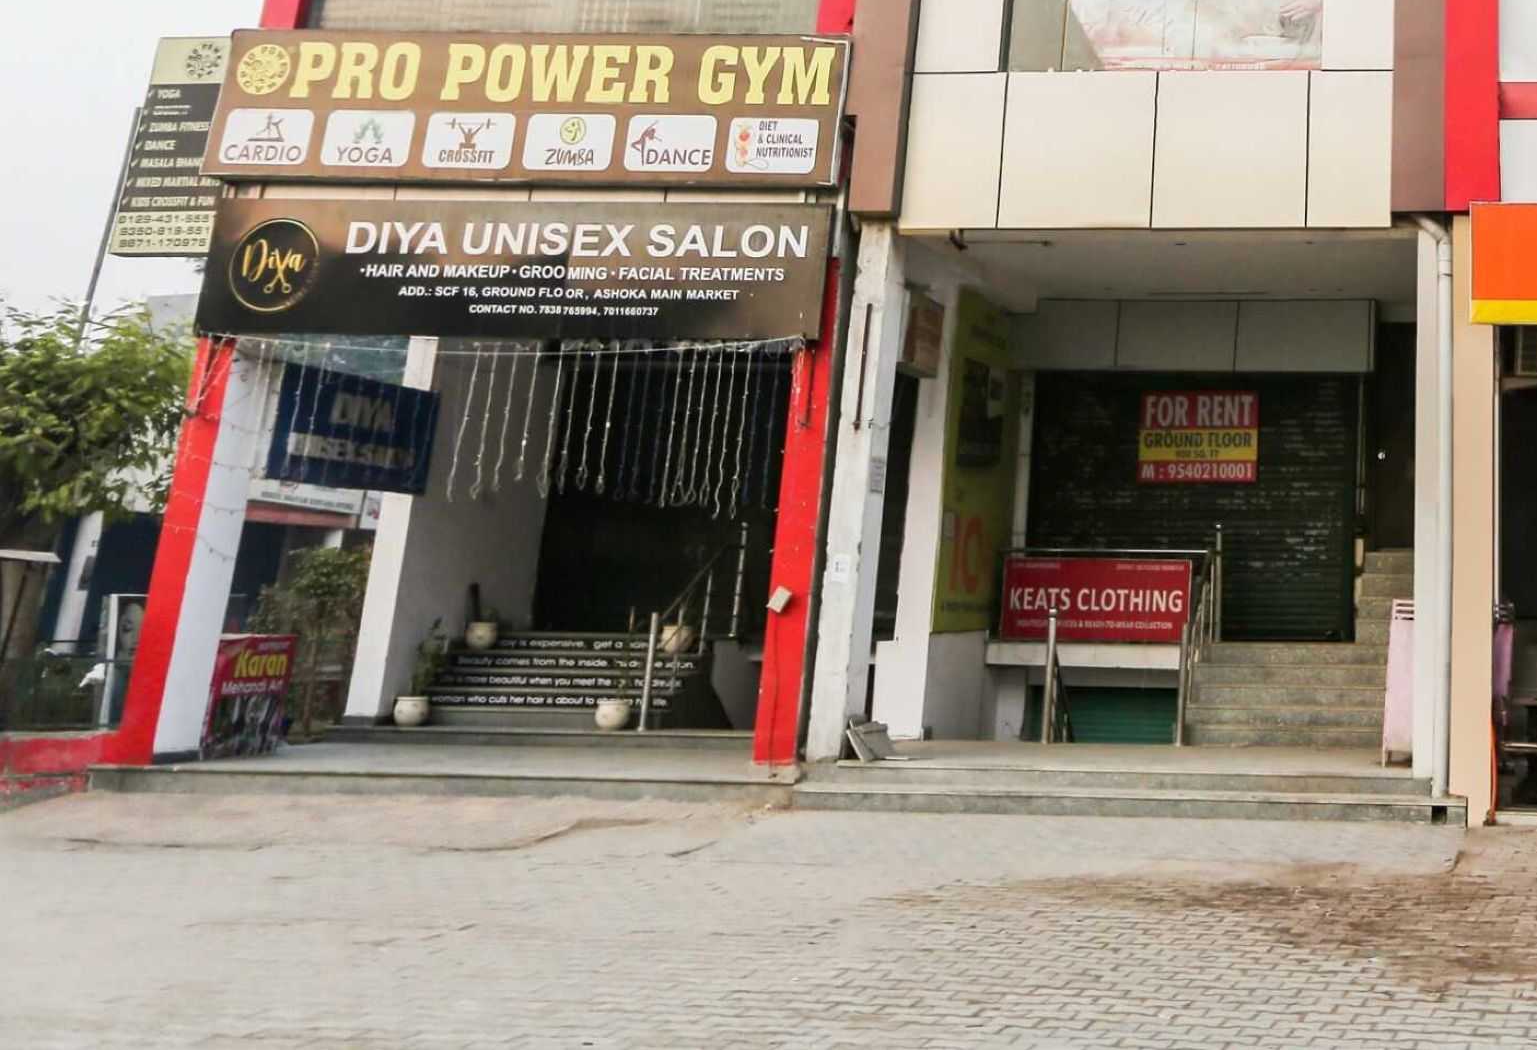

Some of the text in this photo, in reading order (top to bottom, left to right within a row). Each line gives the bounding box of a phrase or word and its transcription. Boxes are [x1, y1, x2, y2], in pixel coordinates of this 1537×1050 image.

[289, 41, 422, 101] PRO
[440, 43, 675, 104] POWER
[698, 45, 836, 105] GYM
[758, 121, 779, 132] DIET
[765, 134, 804, 145] CLINICAL
[224, 144, 302, 162] CARDIO
[336, 146, 393, 164] YOGA
[438, 149, 495, 164] CROSSFIT
[544, 148, 595, 167] ZUMBA
[645, 149, 712, 166] DANCE
[756, 147, 814, 159] NUTRITIONIST
[345, 221, 809, 258] DIYA UNISEX SALON
[365, 265, 406, 278] HAIR
[406, 265, 440, 278] AND
[444, 265, 510, 278] MAKEUP
[617, 266, 675, 281] FACIAL
[680, 267, 785, 282] TREATMENTS
[435, 286, 460, 297] SCF
[482, 287, 536, 298] GROUND
[593, 288, 647, 299] ASHOKA
[650, 289, 682, 300] MAIN
[686, 289, 740, 300] MARKET
[469, 304, 517, 314] CONTACT
[1145, 395, 1254, 427] FOR RENT
[1144, 432, 1252, 448] GROUND FLOOR
[1167, 463, 1253, 479] 9540210001
[1009, 587, 1184, 613] KEATS CLOTHING
[233, 649, 287, 679] Karan
